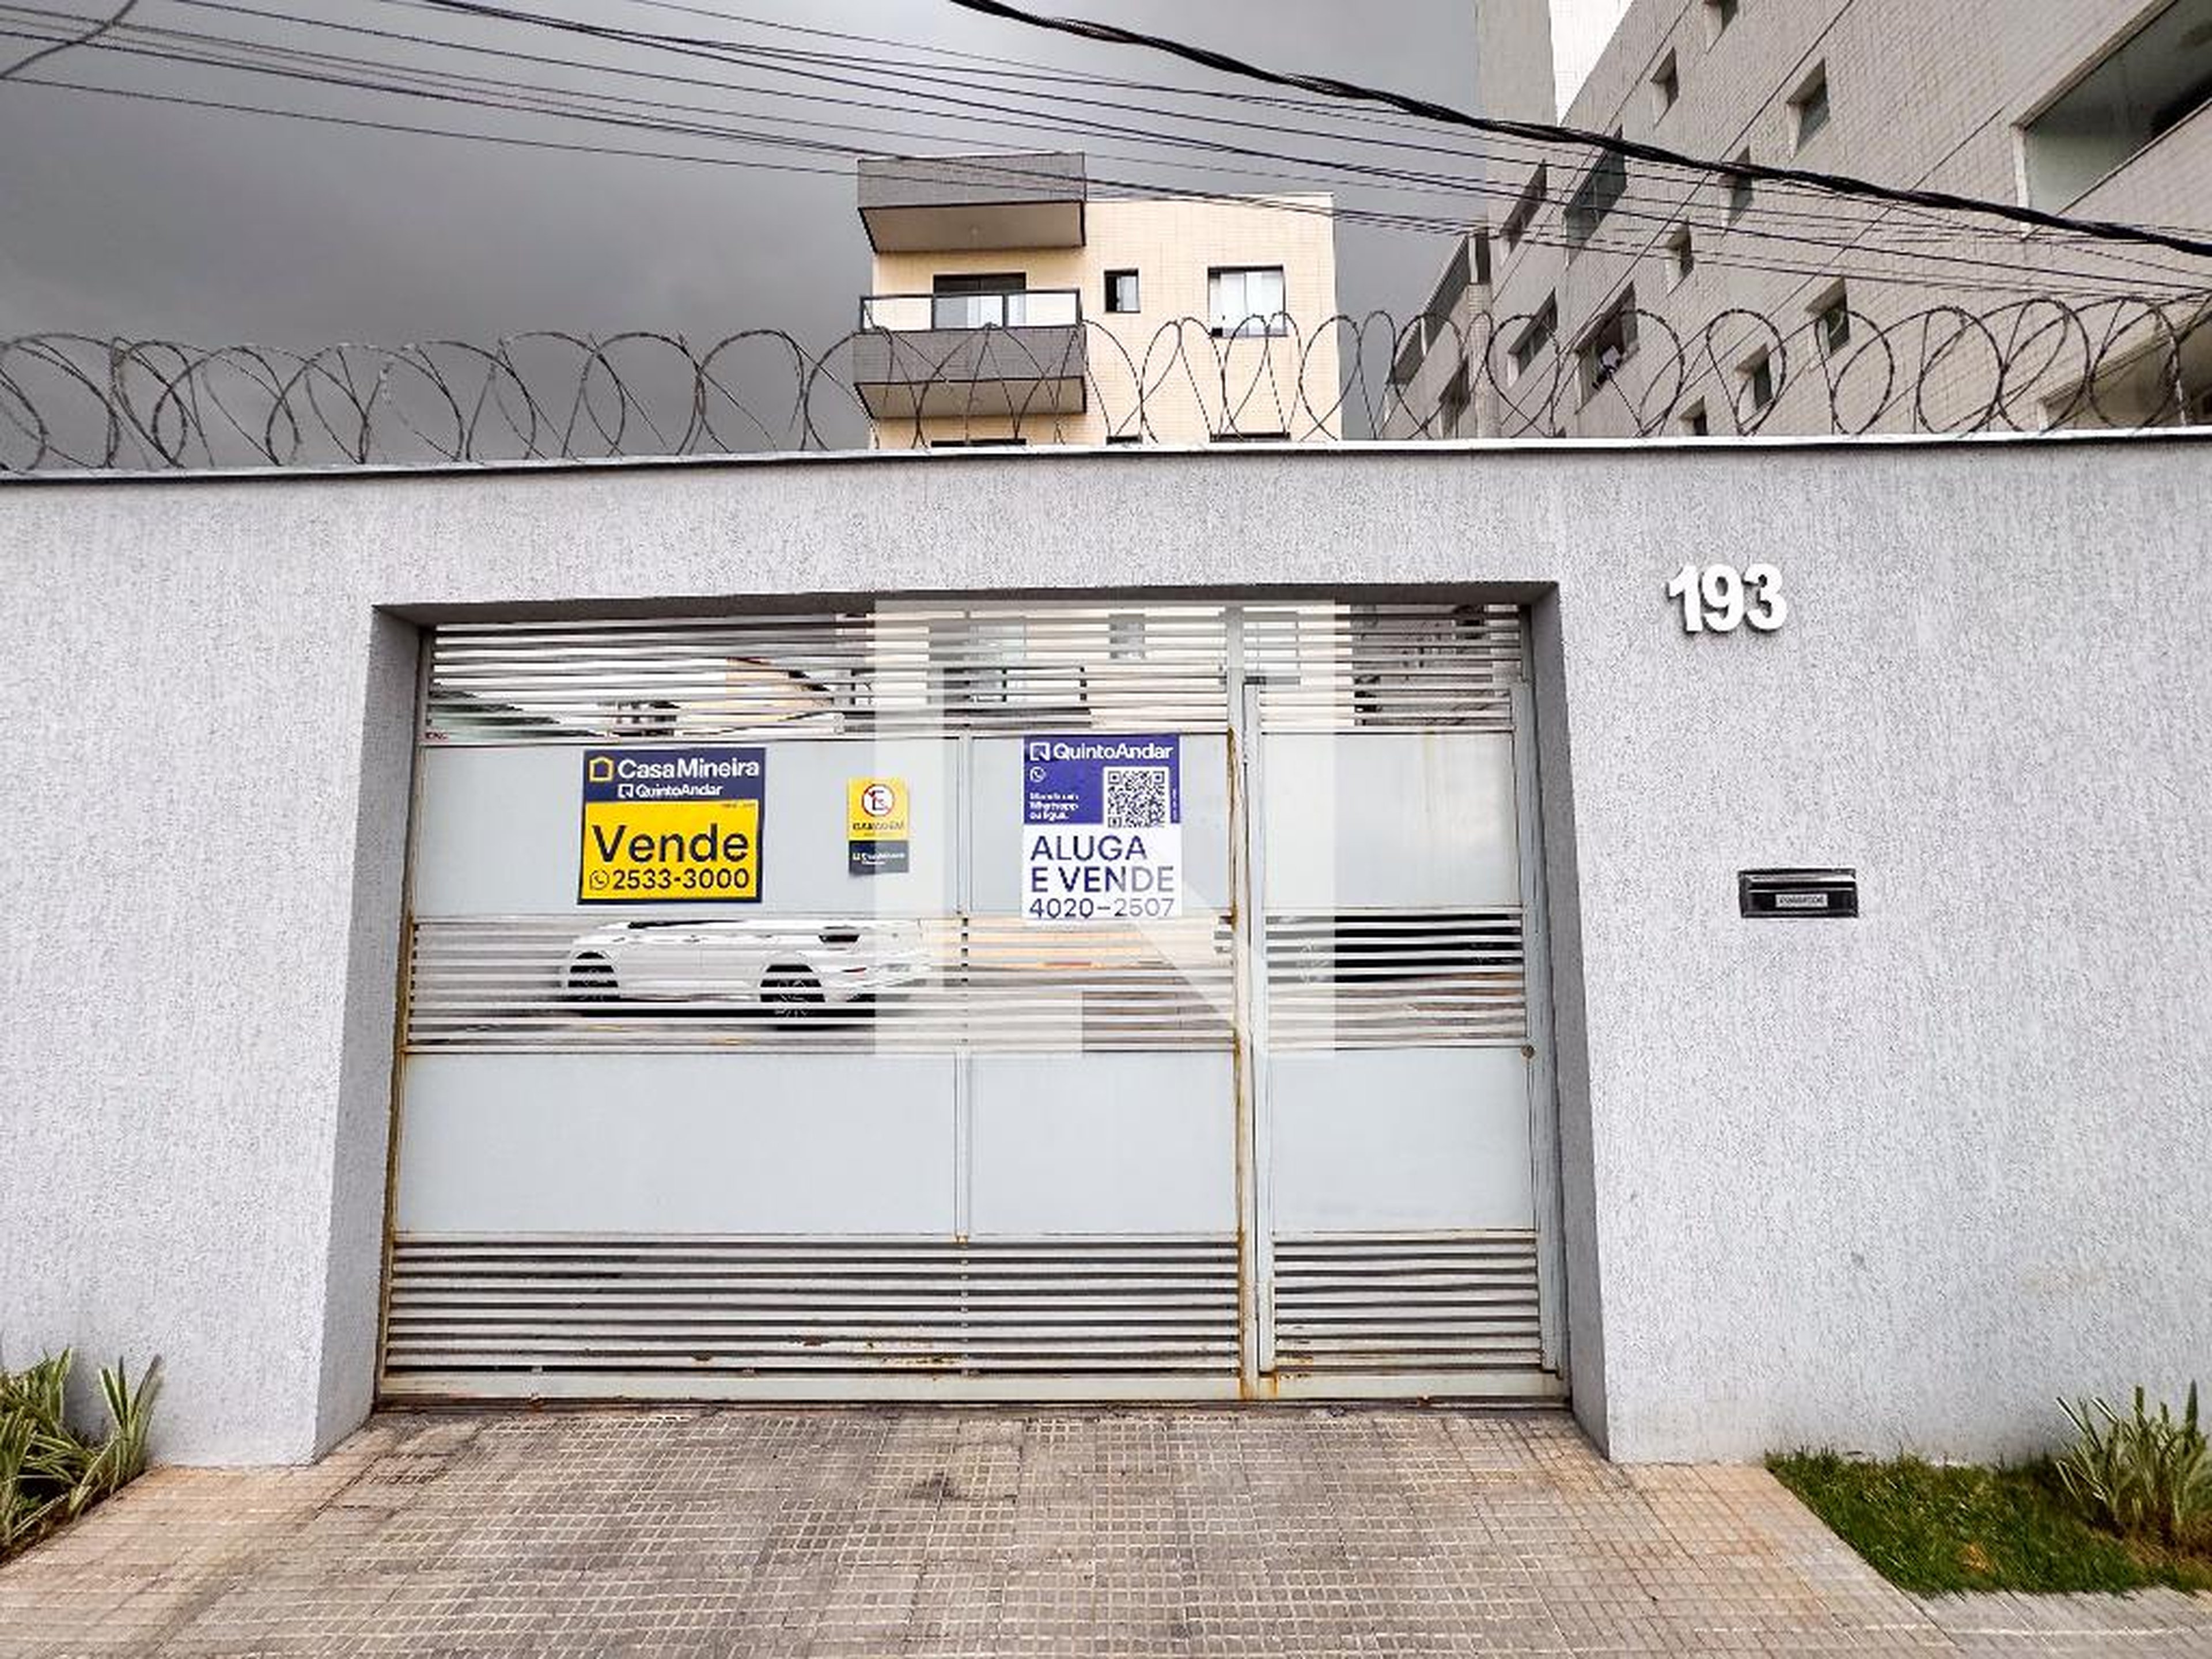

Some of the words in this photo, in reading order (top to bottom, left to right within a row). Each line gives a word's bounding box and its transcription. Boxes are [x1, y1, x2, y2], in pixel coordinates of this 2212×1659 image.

[1666, 563, 1787, 632] 193
[1054, 743, 1173, 760] QuintoAndar
[635, 784, 724, 798] QuintoAndar
[592, 823, 749, 863] Vende
[1030, 835, 1147, 861] ALUGA
[613, 869, 749, 890] 2533-3000
[1032, 867, 1048, 892] E
[1058, 866, 1174, 892] VENDE
[1029, 898, 1175, 919] 4020-2507
